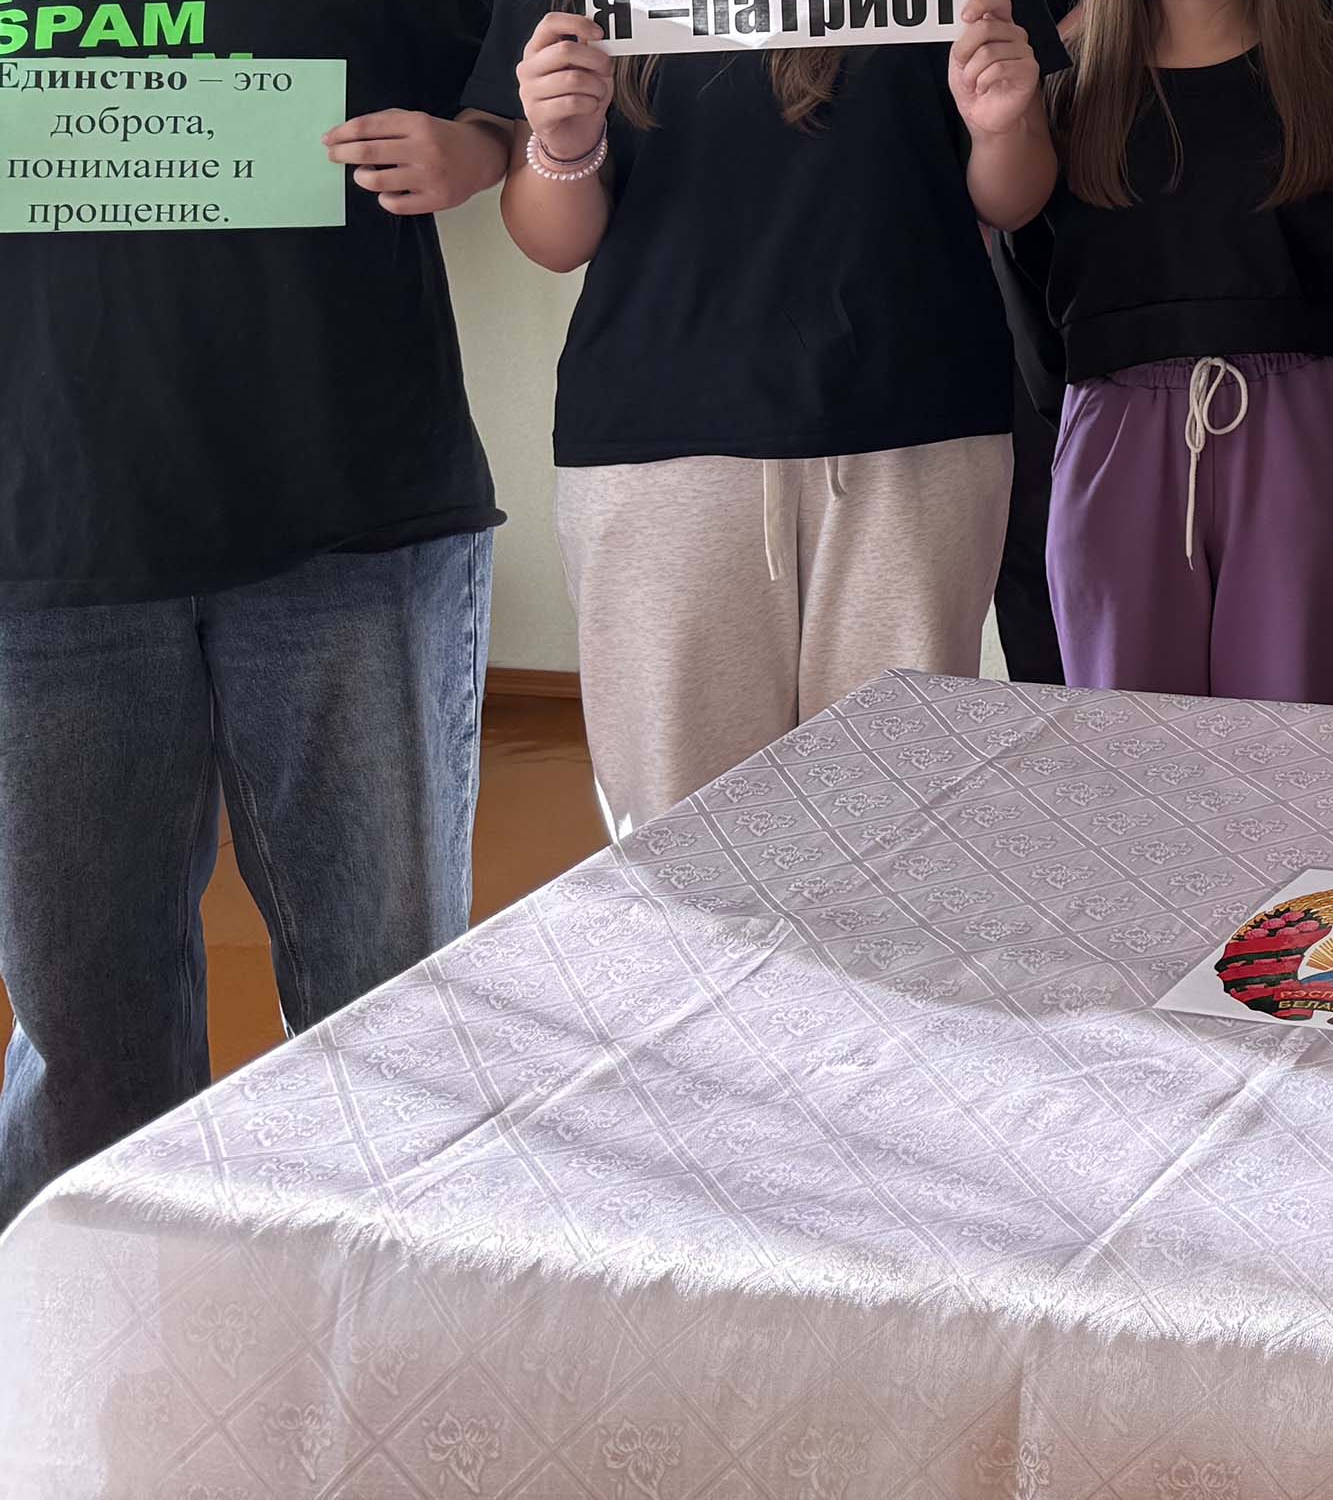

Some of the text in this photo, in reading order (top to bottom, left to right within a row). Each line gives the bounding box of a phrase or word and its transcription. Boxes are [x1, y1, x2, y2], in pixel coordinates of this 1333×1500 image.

[0, 62, 188, 92] Единство
[233, 71, 293, 92] это
[50, 106, 215, 142] доброта,
[7, 158, 255, 180] понимание и
[27, 202, 230, 231] прощение.
